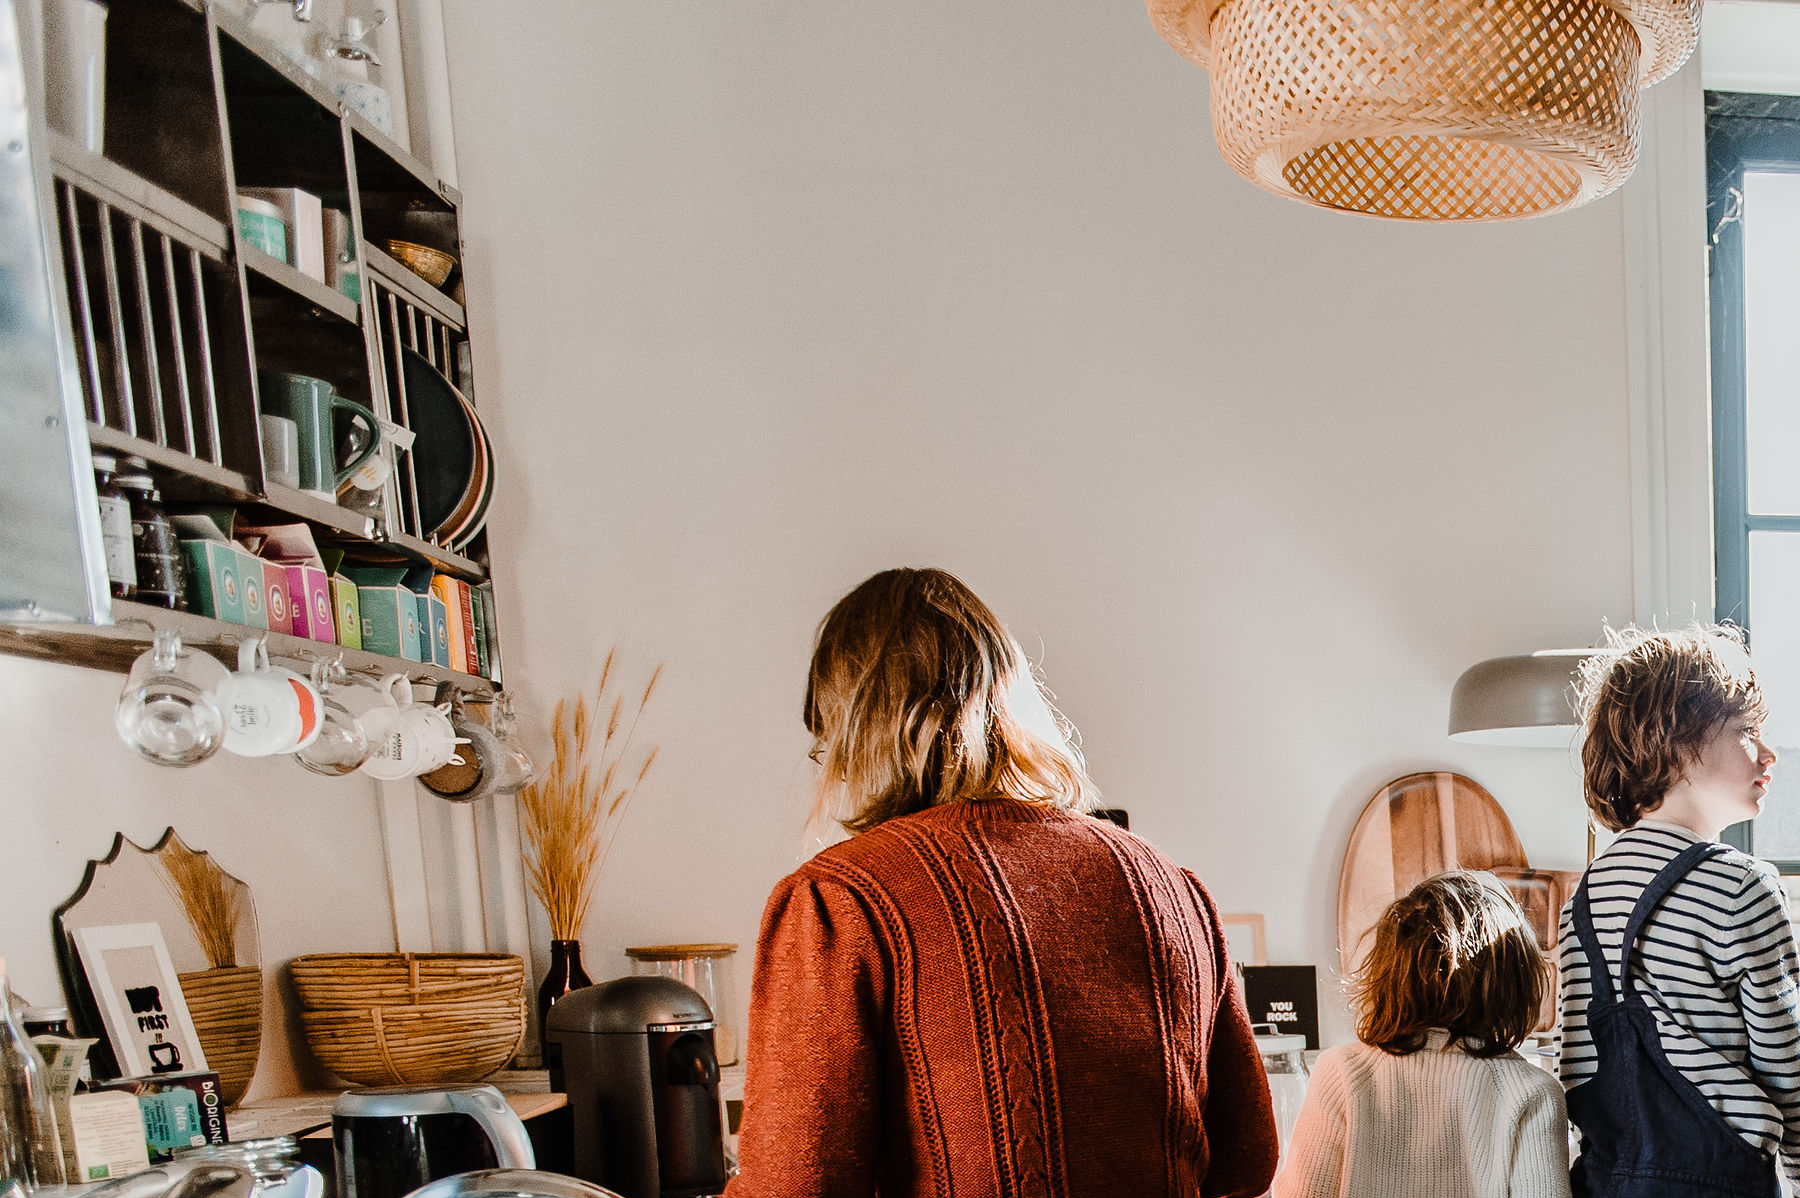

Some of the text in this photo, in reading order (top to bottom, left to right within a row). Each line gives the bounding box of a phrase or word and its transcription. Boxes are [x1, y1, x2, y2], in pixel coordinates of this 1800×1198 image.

[1270, 1001, 1293, 1012] YOU
[137, 1014, 170, 1033] FIRST
[1266, 1012, 1298, 1022] ROCK
[201, 1081, 224, 1145] BIORIGINE
